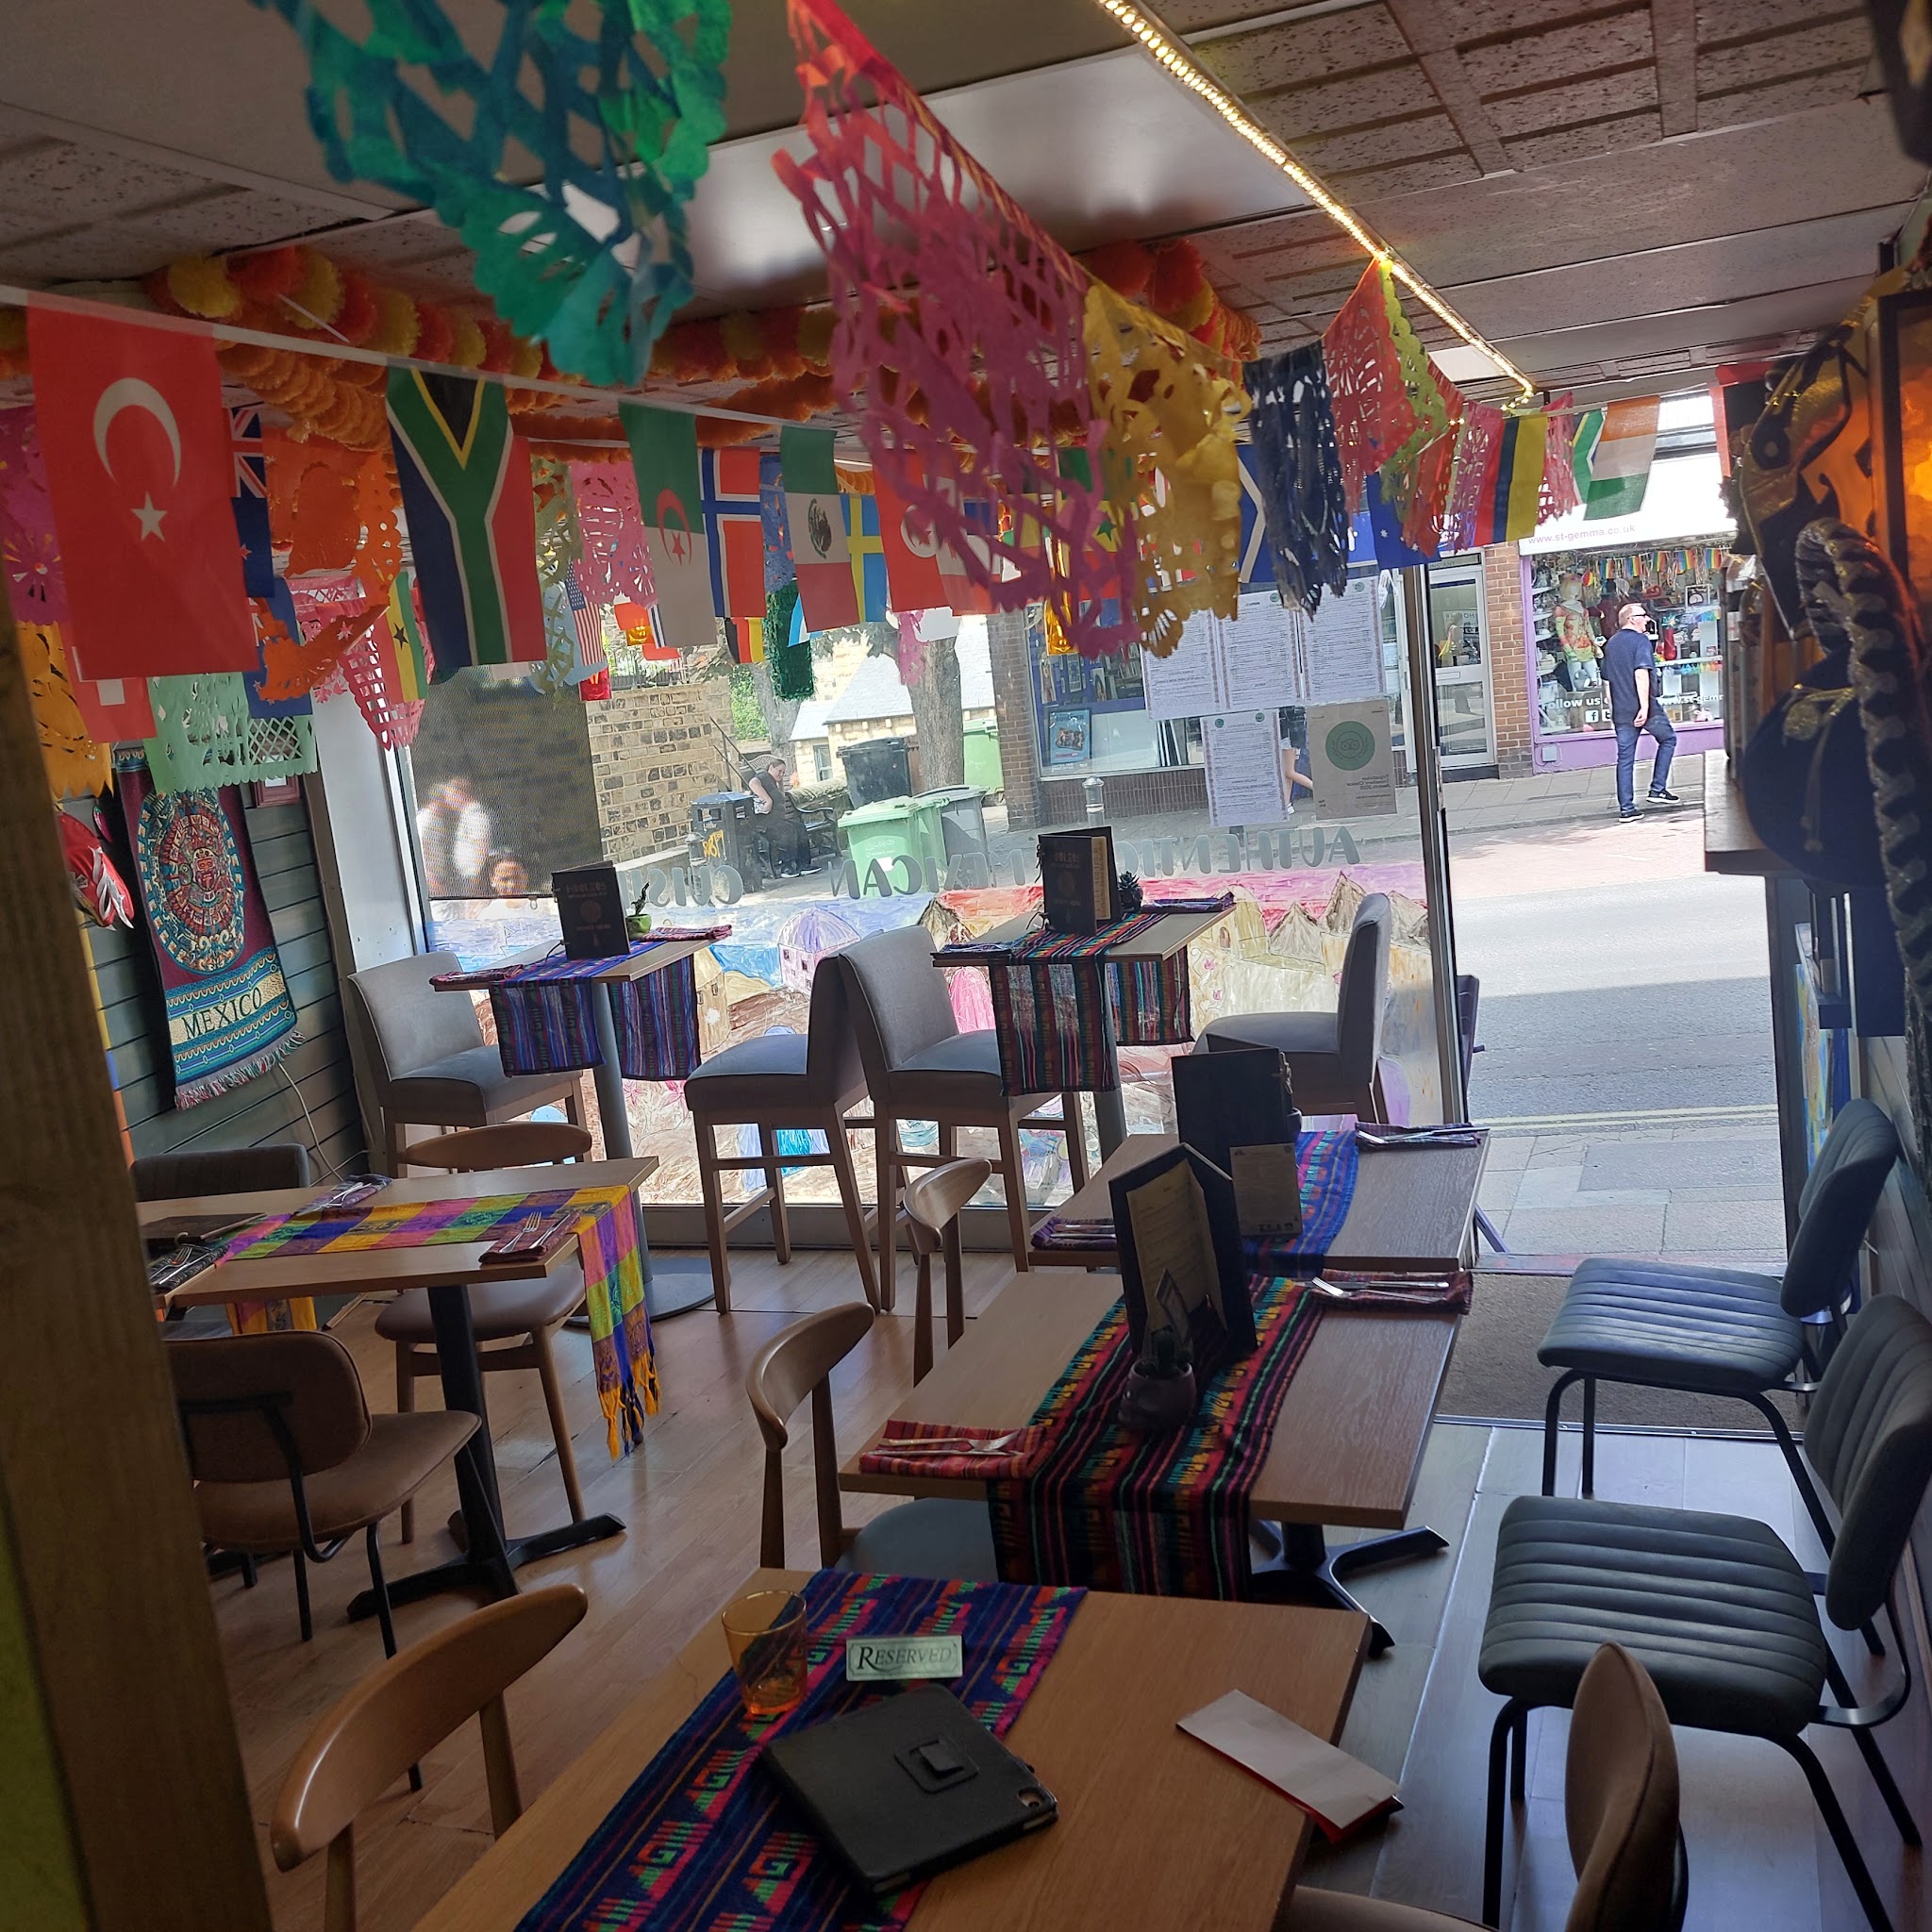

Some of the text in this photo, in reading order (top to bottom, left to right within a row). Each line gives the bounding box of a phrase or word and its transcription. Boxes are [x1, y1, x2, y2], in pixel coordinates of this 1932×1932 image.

[1527, 525, 1636, 543] www.st-gemma.co.uk
[1586, 697, 1601, 707] us
[181, 987, 262, 1040] MEXICO
[857, 1645, 952, 1673] RESERVED
